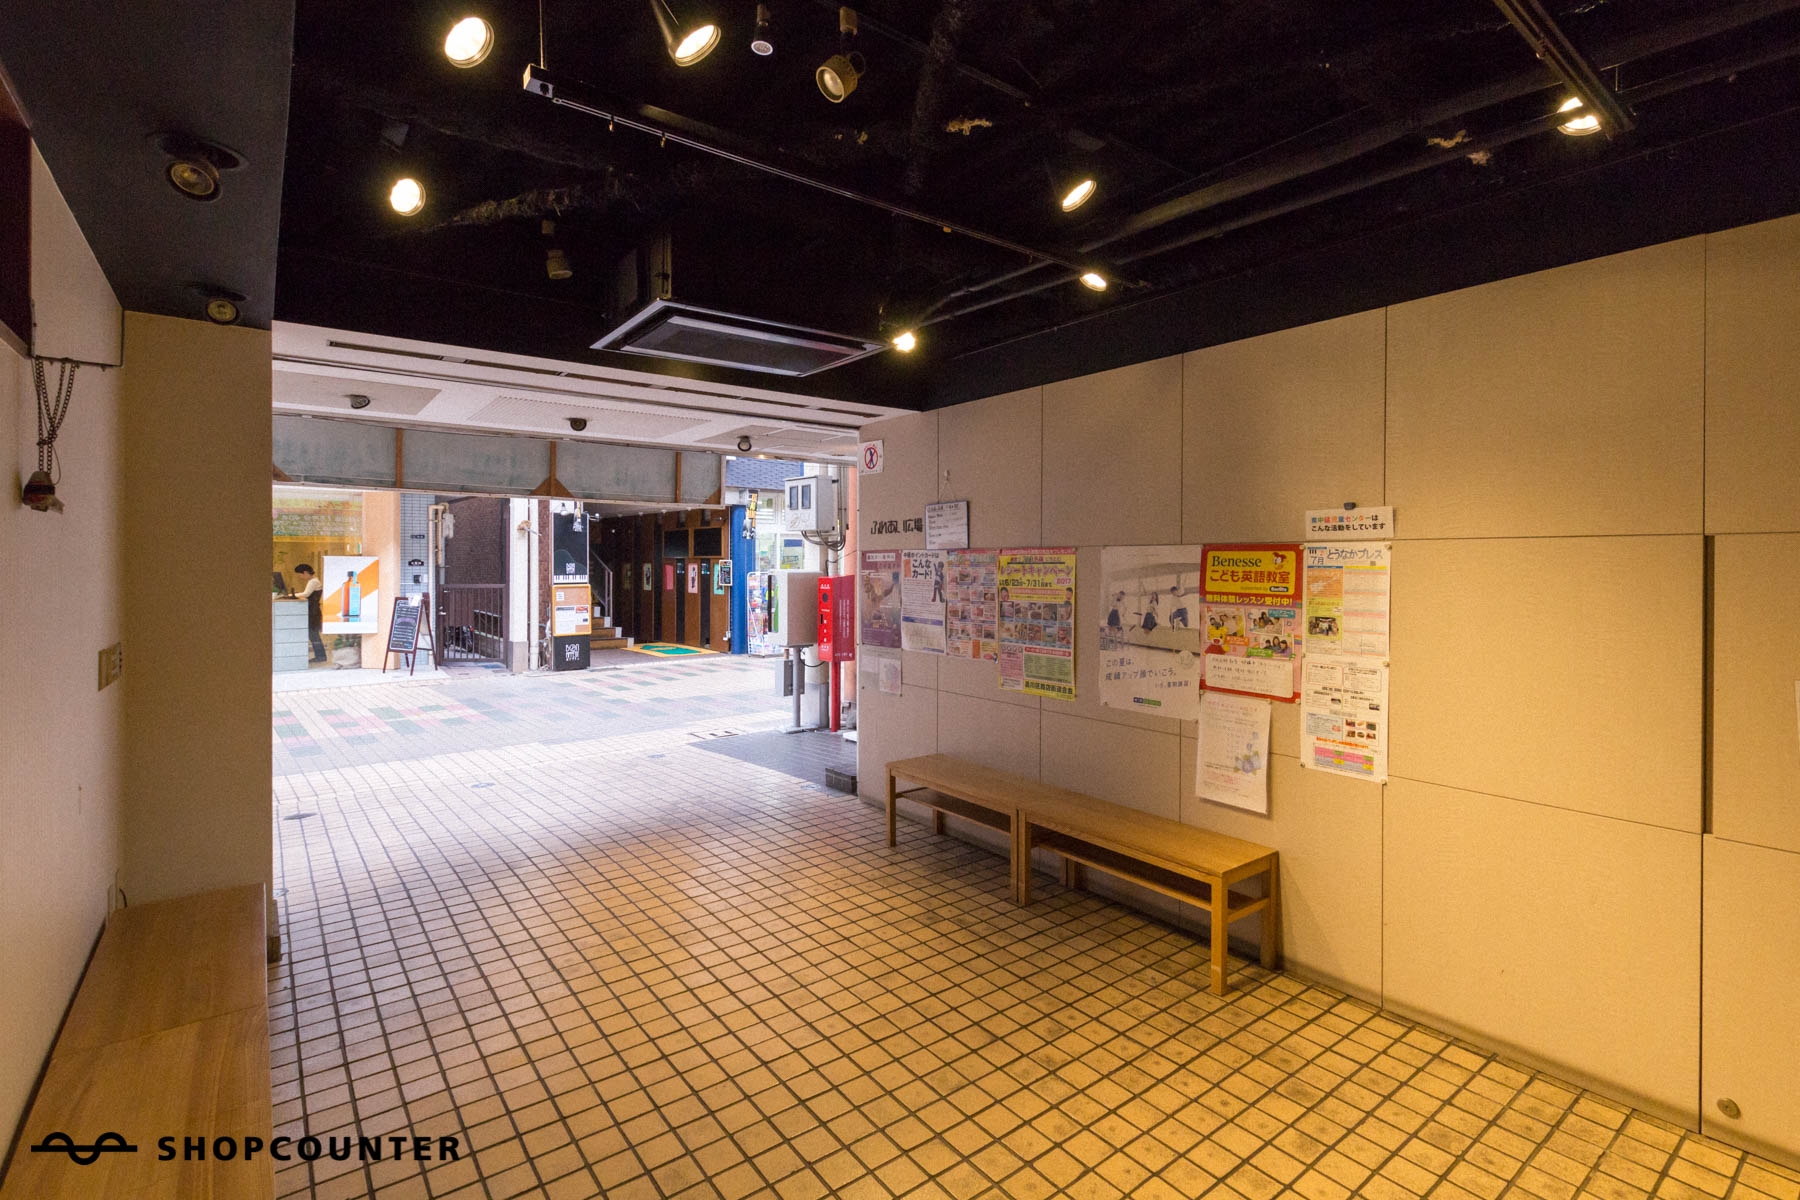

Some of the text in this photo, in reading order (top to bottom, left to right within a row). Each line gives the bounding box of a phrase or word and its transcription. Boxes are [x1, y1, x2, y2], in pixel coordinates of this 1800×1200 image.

[1311, 523, 1387, 532] こんな活動をしています
[1327, 548, 1384, 560] とうなかプレス
[911, 559, 932, 569] こんな
[1211, 555, 1263, 567] Benesse
[1000, 564, 1074, 577] レシートキャンペーン
[1209, 569, 1291, 584] こども英語教室
